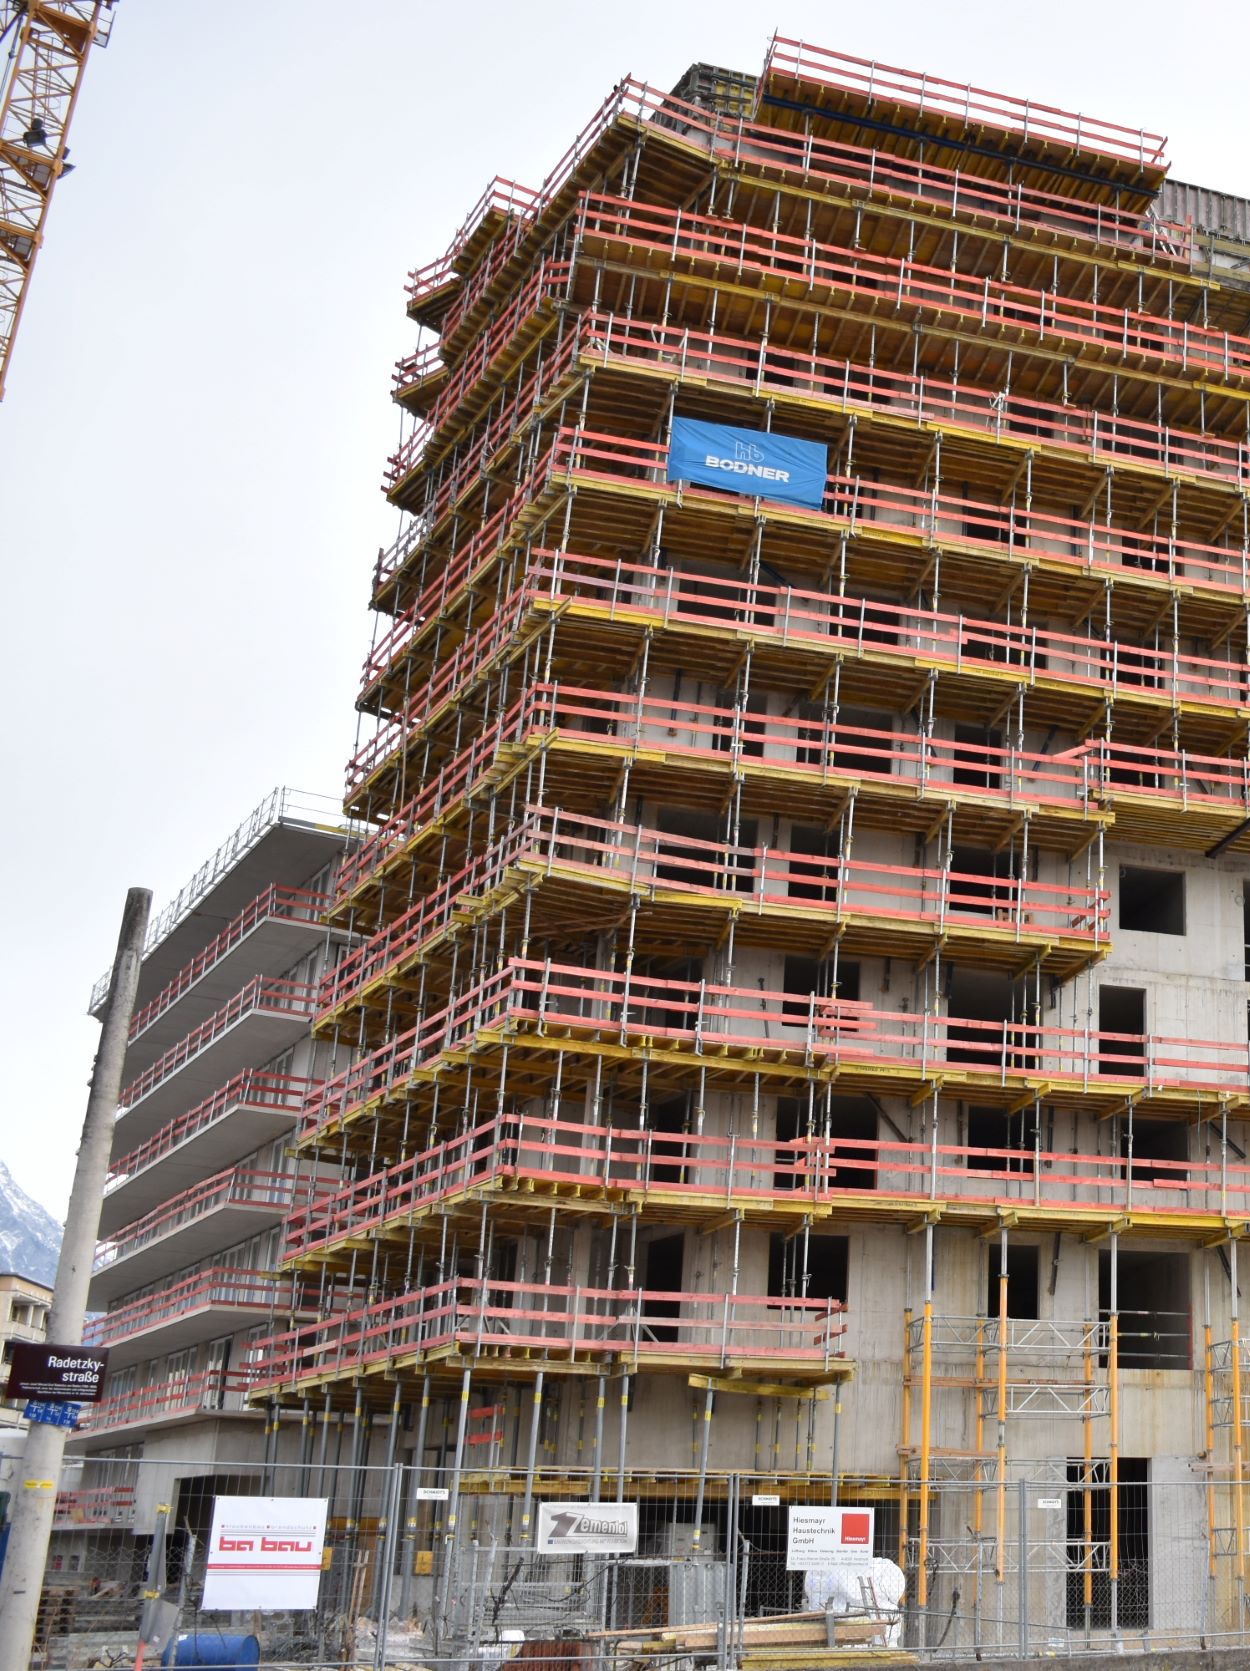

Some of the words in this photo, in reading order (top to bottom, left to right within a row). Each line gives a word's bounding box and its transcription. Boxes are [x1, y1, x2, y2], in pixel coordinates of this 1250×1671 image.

[705, 456, 789, 482] BODNER
[48, 1355, 104, 1372] Radetzky-
[62, 1371, 99, 1383] straße
[793, 1517, 826, 1525] Hiesmayr
